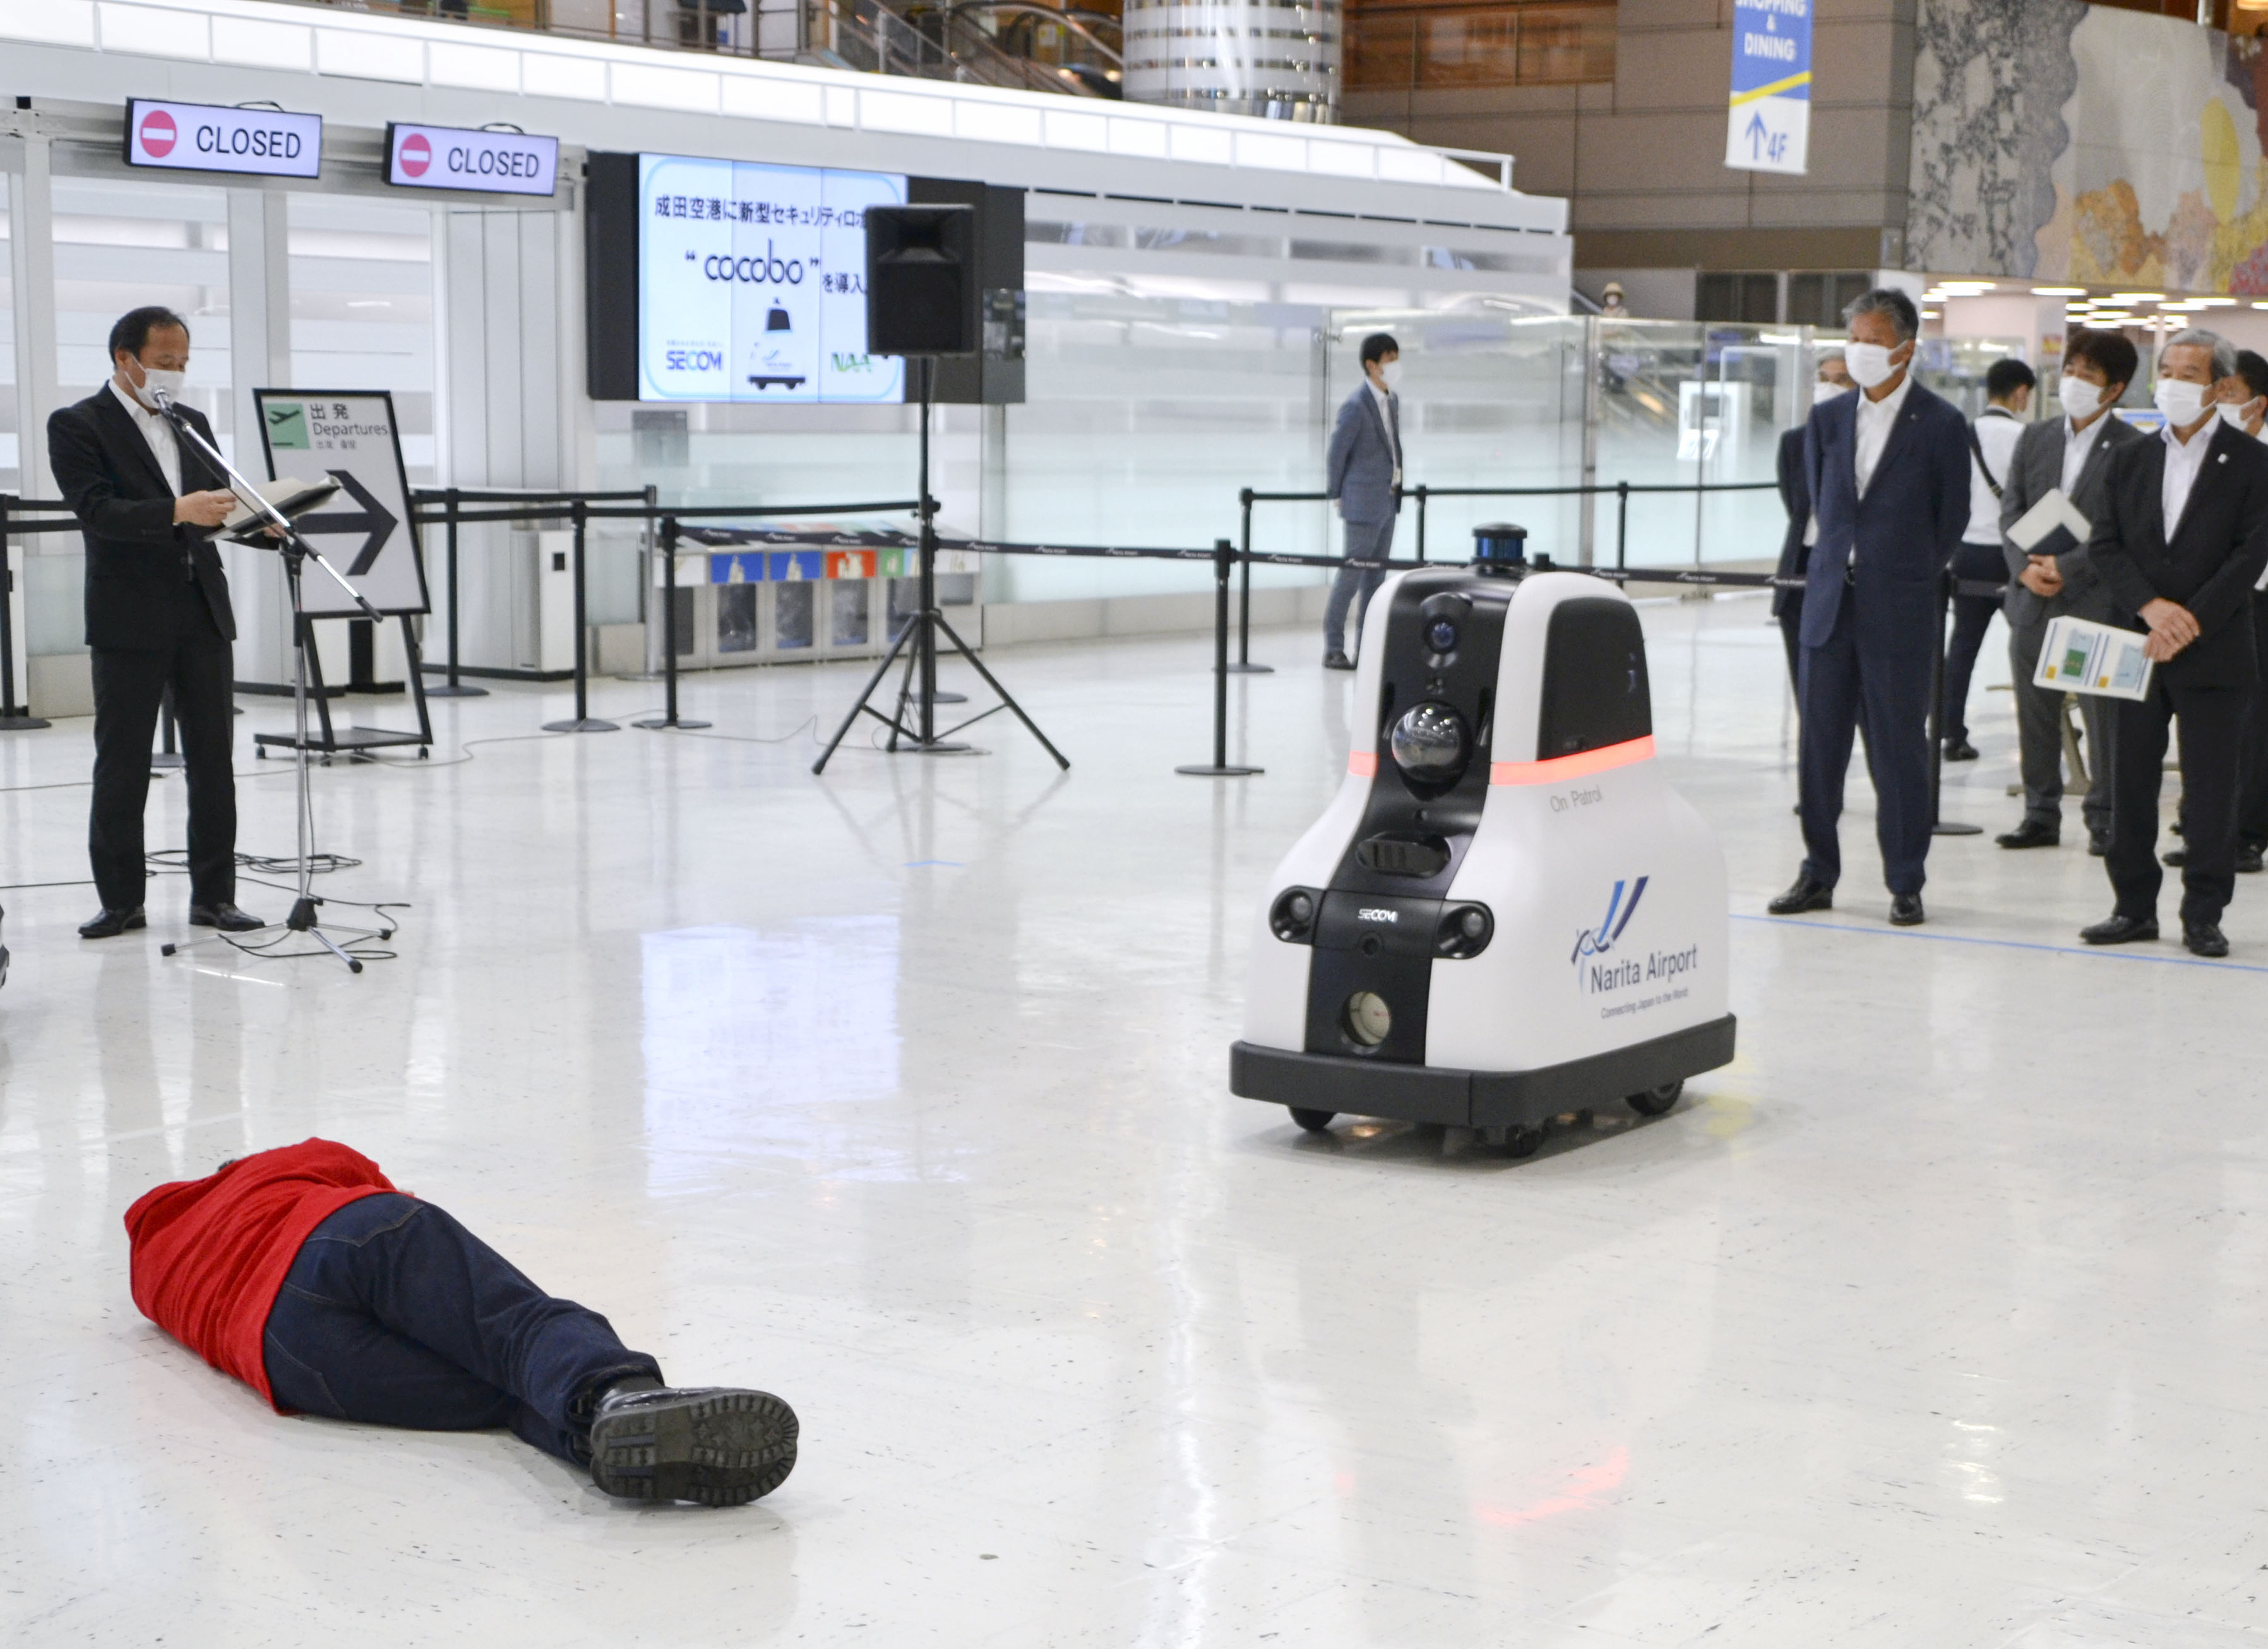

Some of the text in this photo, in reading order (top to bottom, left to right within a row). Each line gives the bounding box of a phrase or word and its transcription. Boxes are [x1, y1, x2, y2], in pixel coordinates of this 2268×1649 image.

[1744, 32, 1796, 62] DINING
[196, 124, 301, 158] CLOSED
[1767, 131, 1788, 163] 4F
[448, 146, 539, 178] CLOSED
[666, 350, 722, 371] SECOM
[309, 403, 349, 420] 出発
[313, 422, 388, 439] Departures
[1550, 785, 1603, 812] On Patrol
[1358, 908, 1398, 922] SECOM
[1591, 943, 1697, 994] Narita Airport
